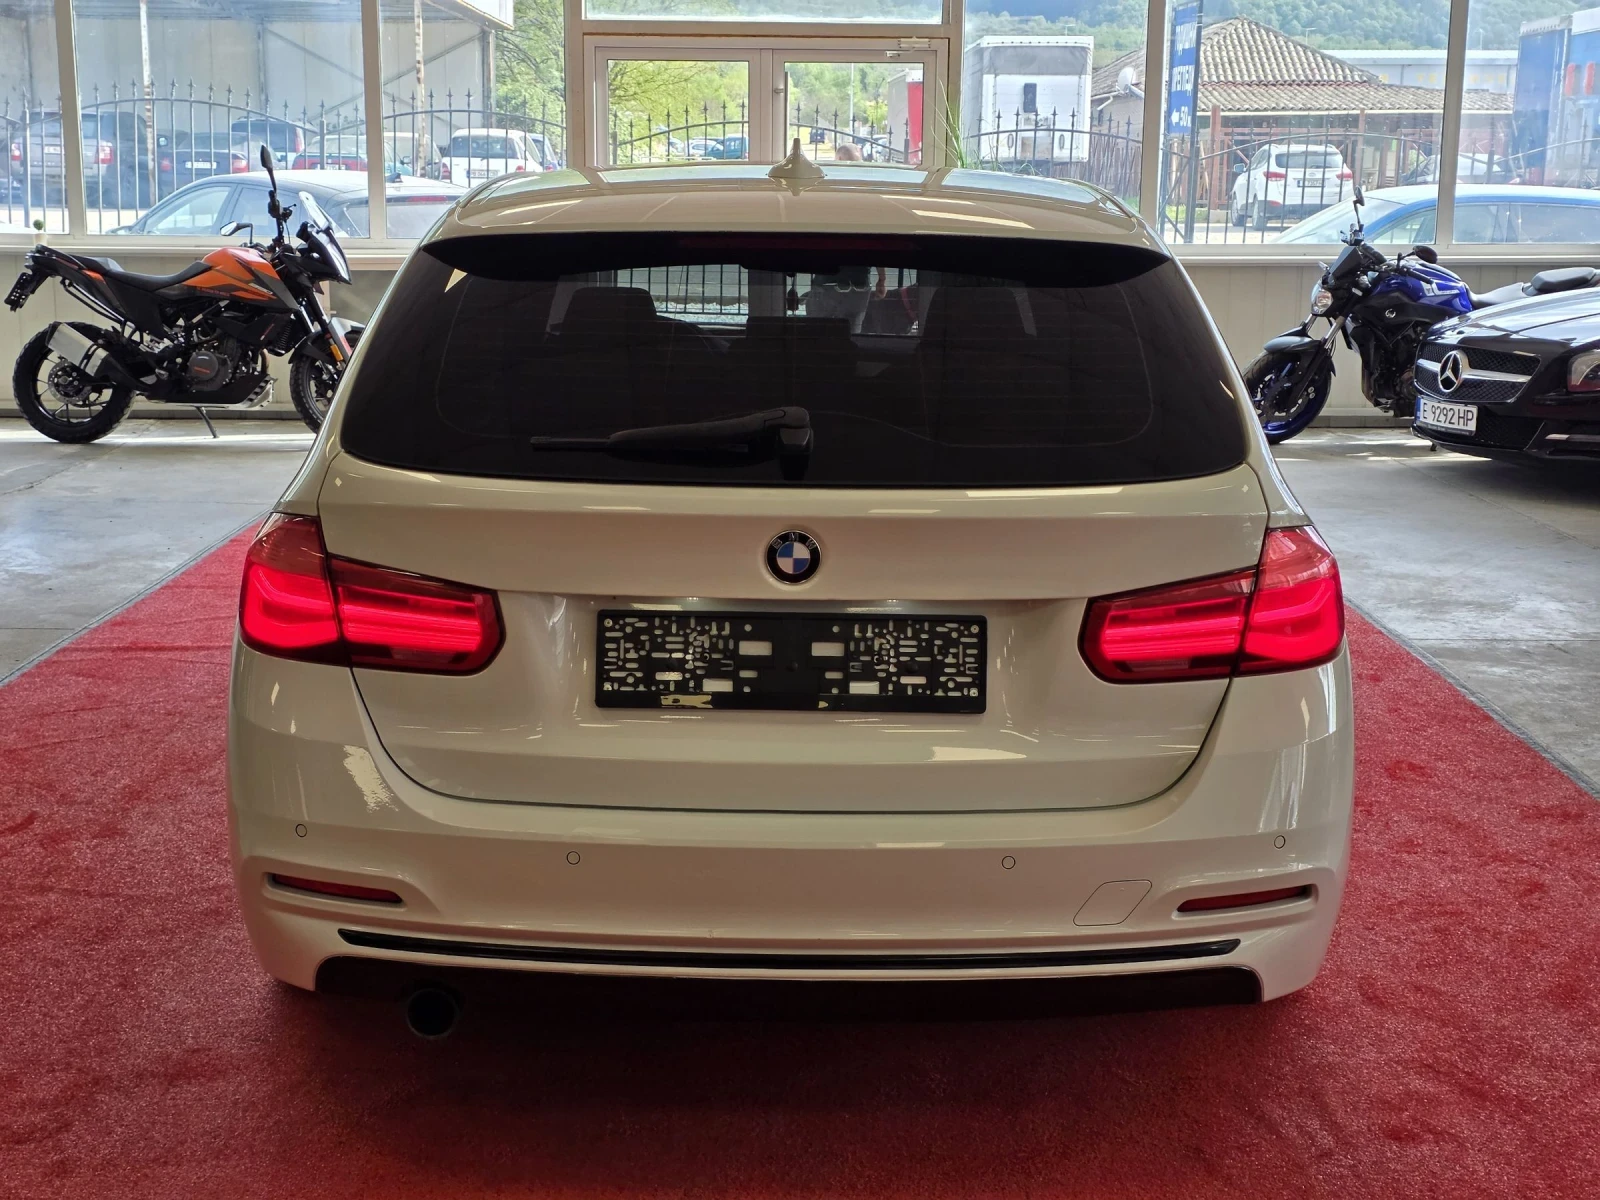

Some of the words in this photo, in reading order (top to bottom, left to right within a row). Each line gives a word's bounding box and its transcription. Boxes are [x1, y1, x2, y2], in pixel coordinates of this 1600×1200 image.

[1423, 402, 1428, 419] E
[1431, 405, 1455, 425] 9292
[1458, 409, 1474, 426] HP
[772, 532, 817, 549] BMW
